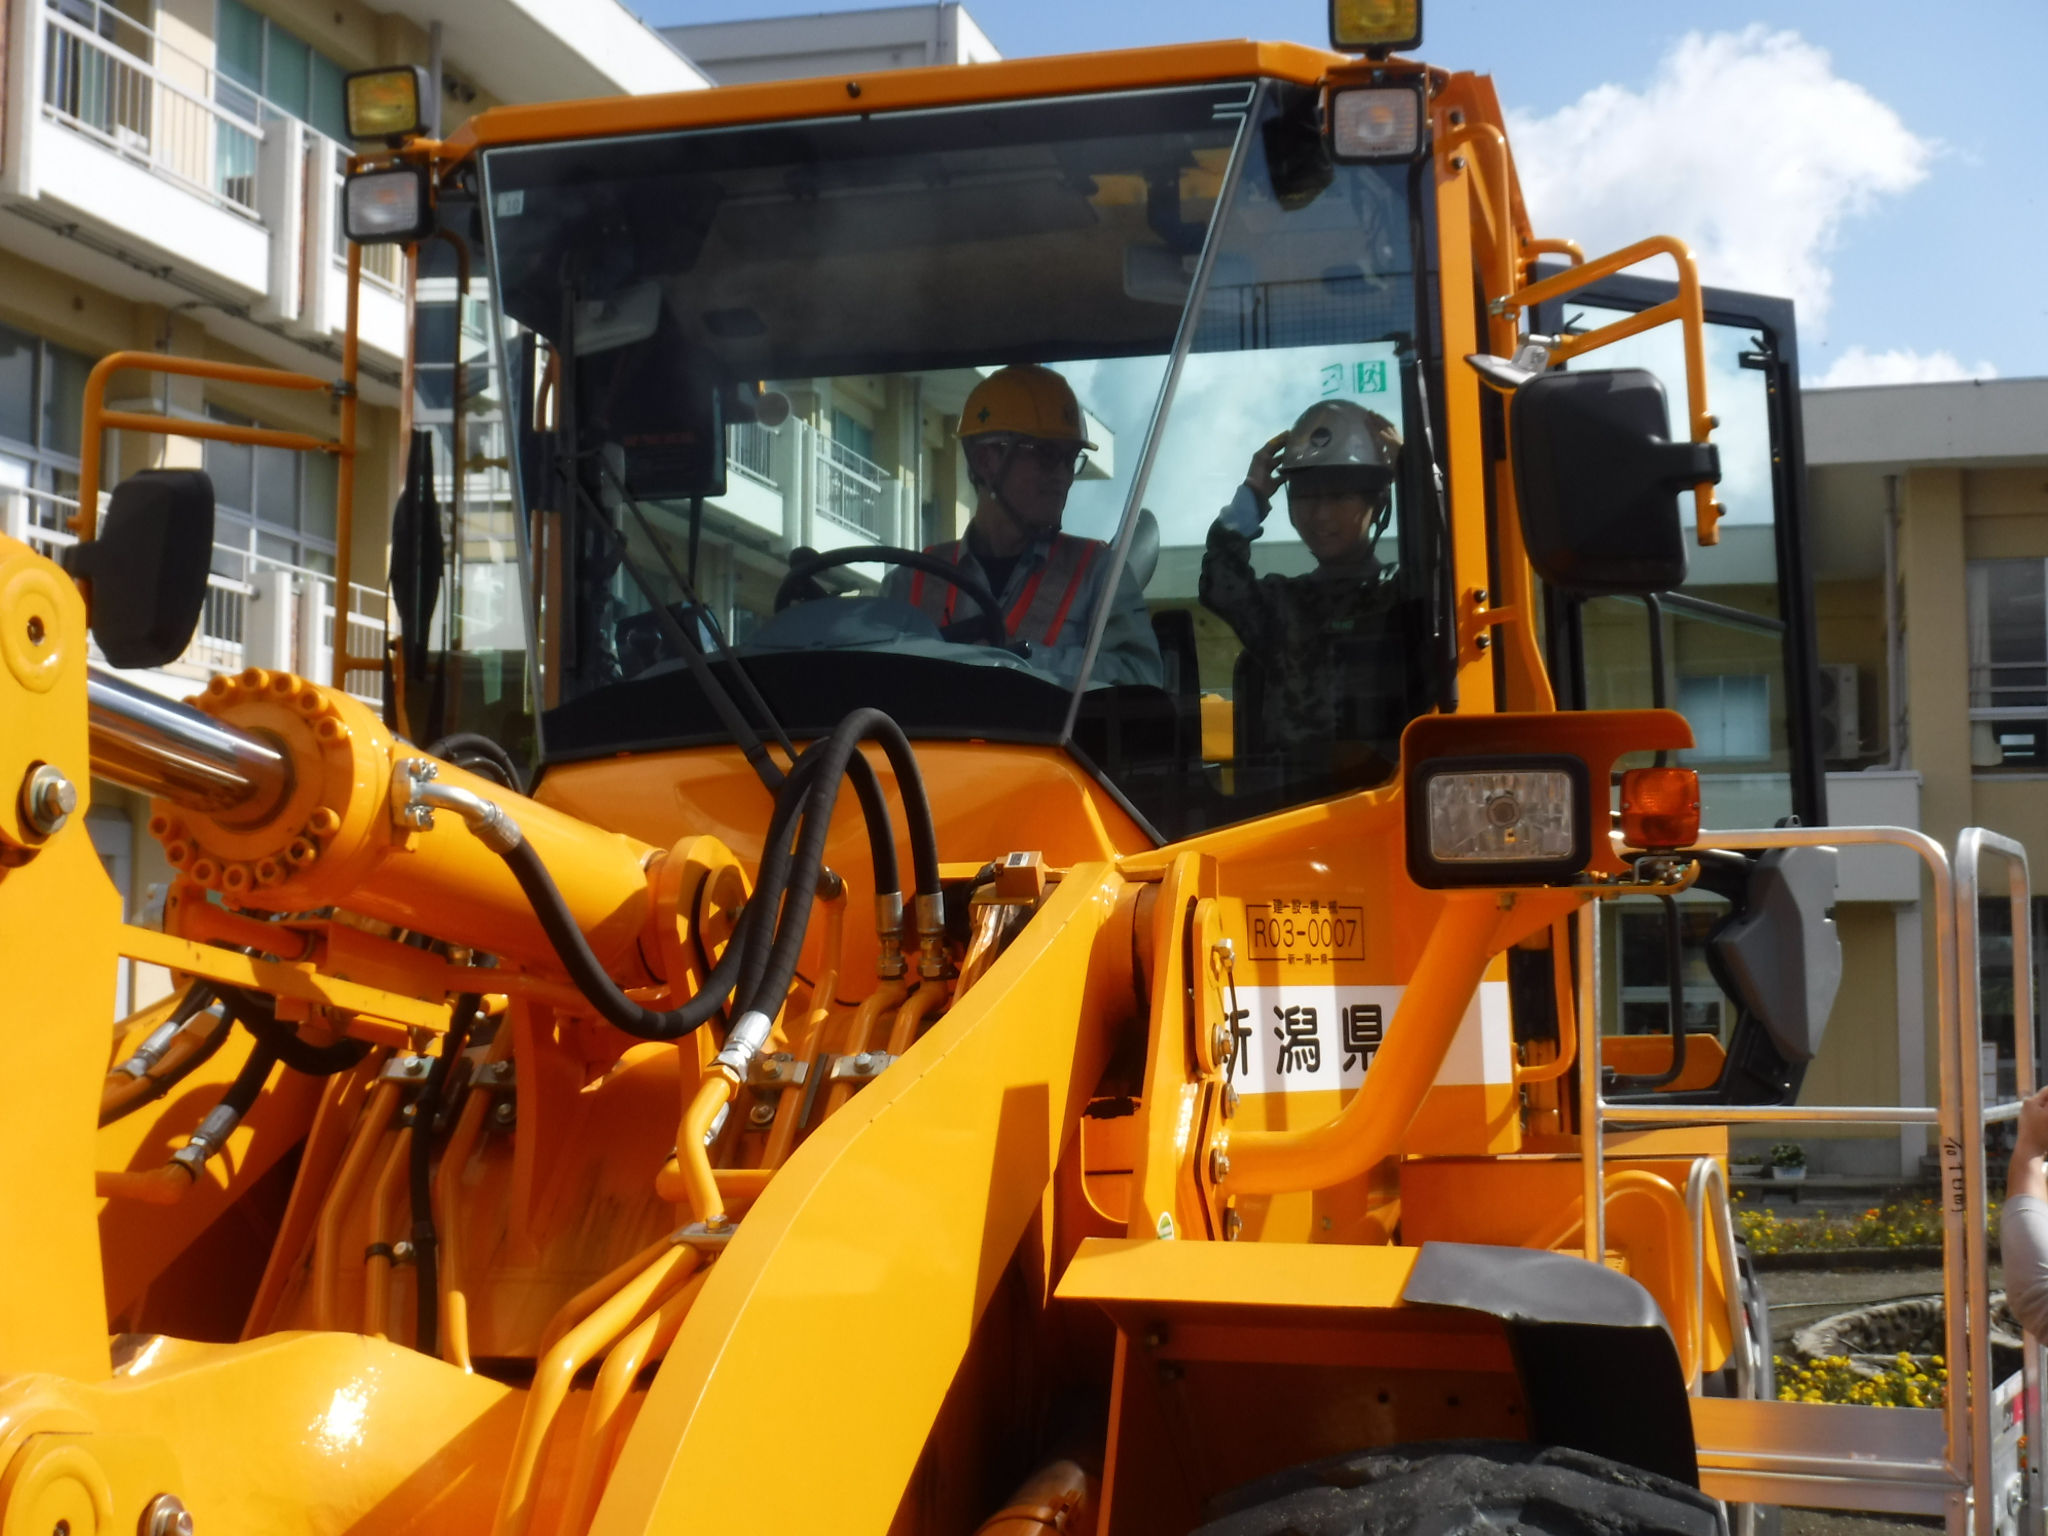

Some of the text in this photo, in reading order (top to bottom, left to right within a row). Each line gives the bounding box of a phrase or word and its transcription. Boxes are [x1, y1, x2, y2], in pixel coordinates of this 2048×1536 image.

[1254, 918, 1357, 948] R03-0007
[1287, 953, 1328, 965] 新潟県
